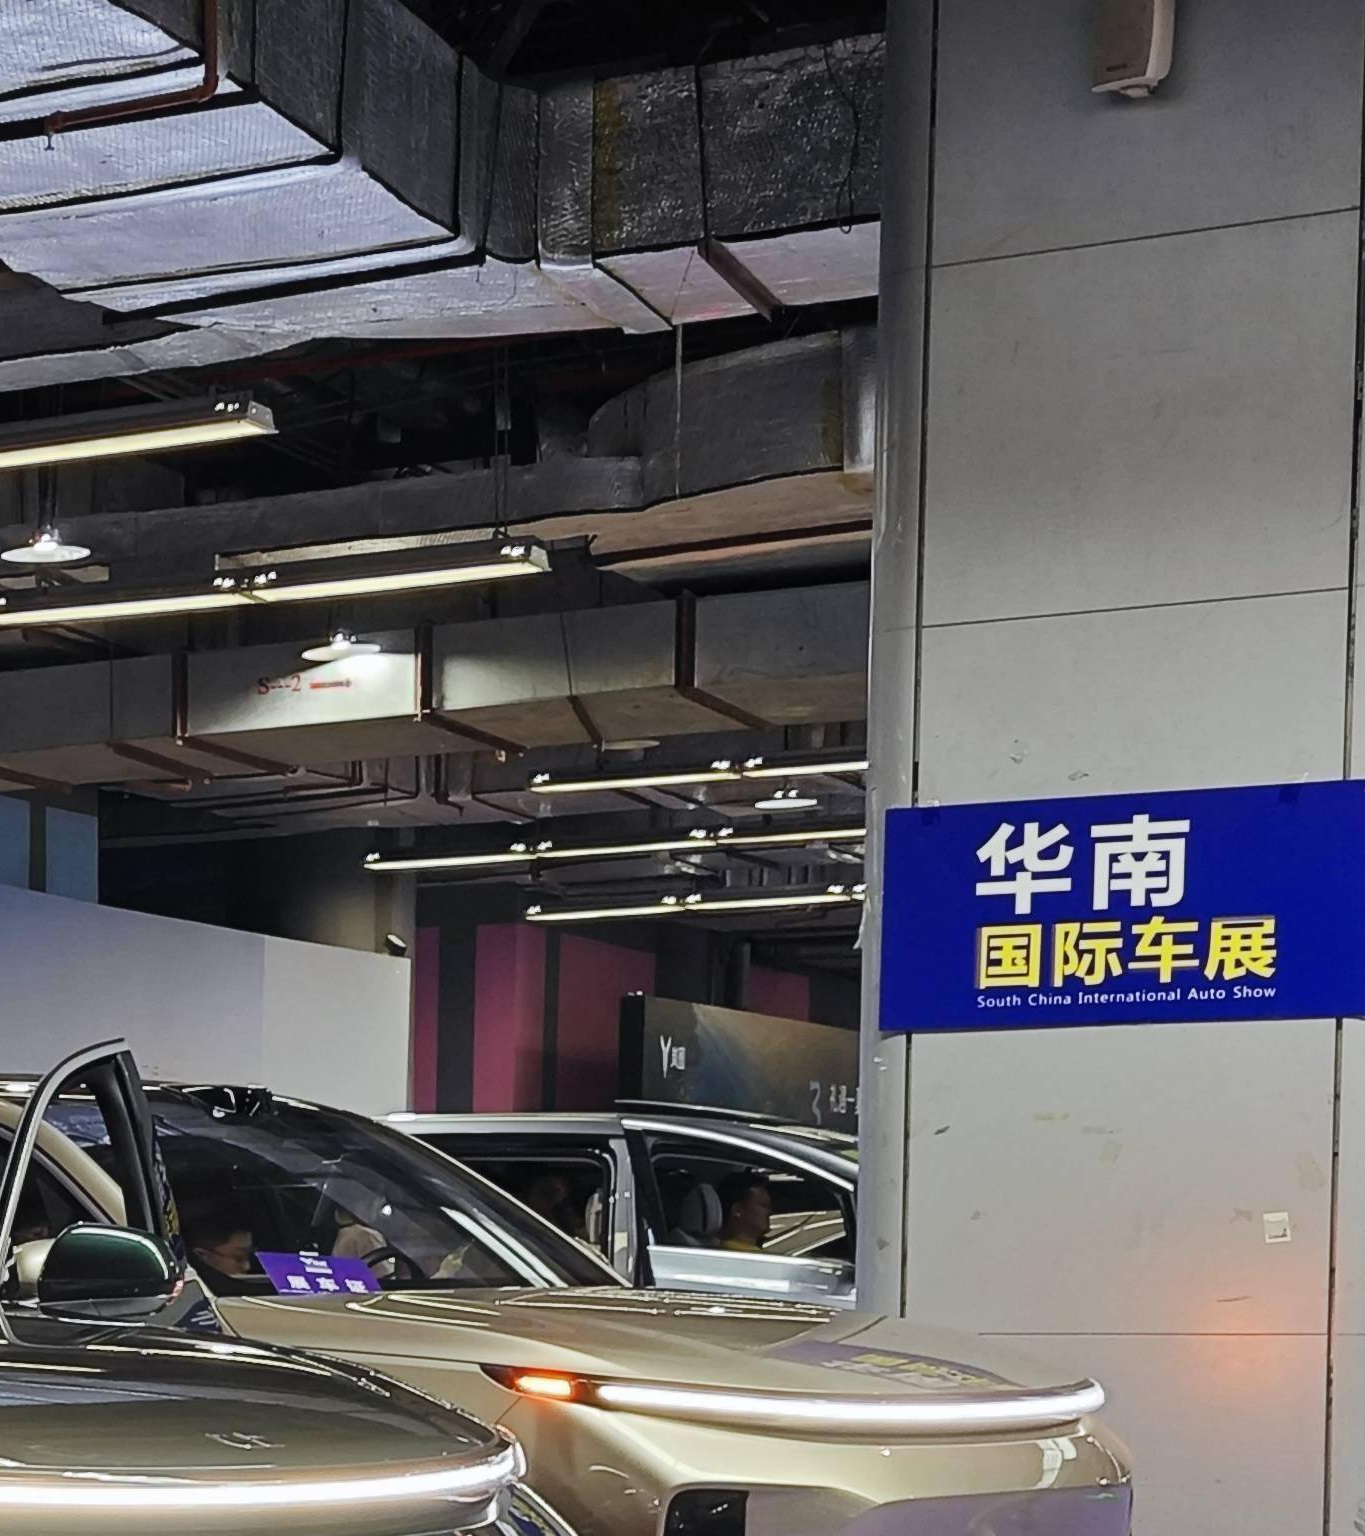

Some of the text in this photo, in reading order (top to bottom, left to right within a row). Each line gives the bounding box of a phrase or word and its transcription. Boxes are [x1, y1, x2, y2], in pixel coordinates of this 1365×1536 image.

[975, 813, 1191, 915] 华南
[976, 915, 1278, 990] 国际车展
[977, 984, 1276, 1008] South China International Auto Show
